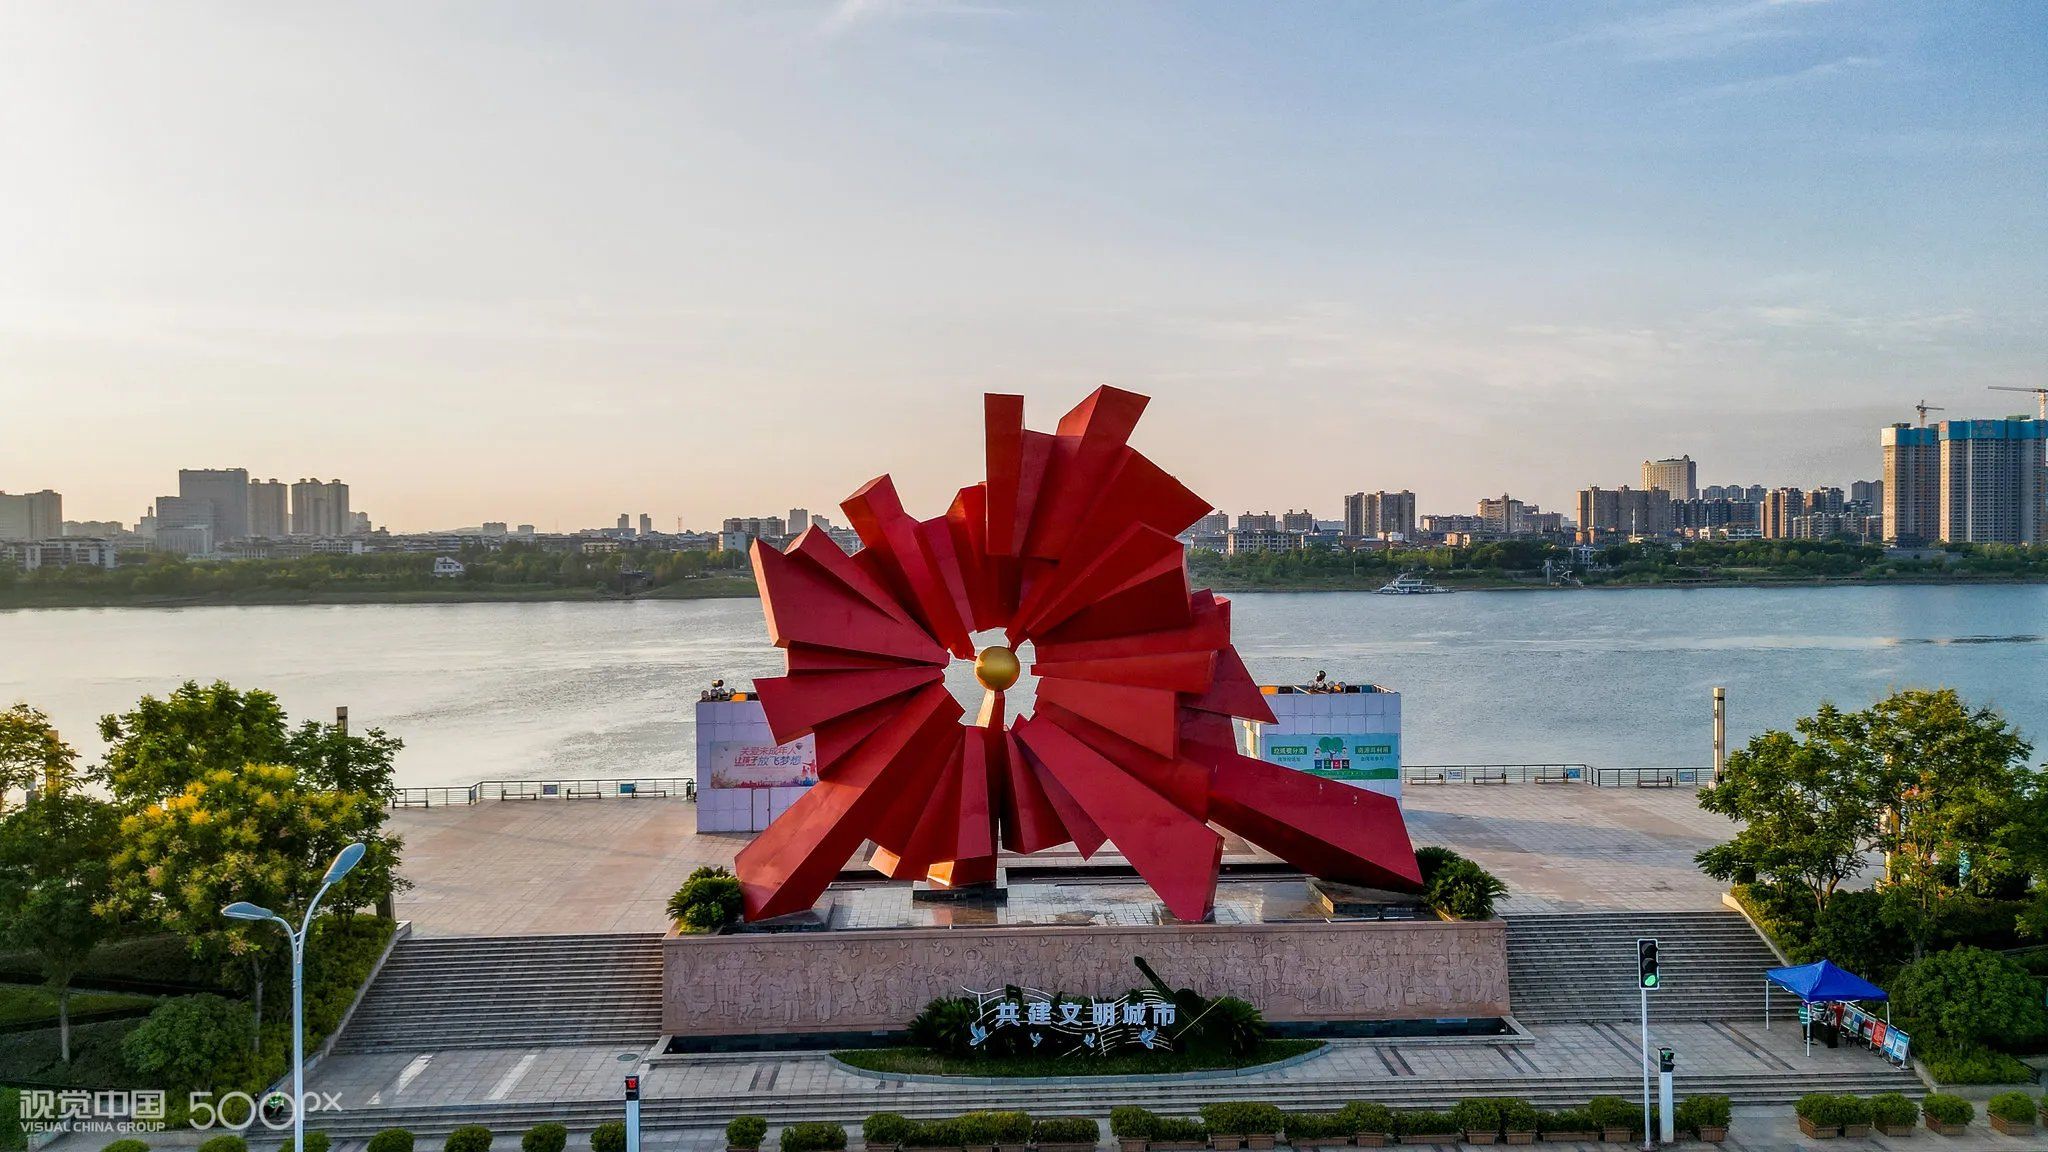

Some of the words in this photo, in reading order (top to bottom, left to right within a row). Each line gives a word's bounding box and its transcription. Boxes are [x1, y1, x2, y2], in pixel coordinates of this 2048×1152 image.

[995, 1002, 1177, 1027] 共建文明城市
